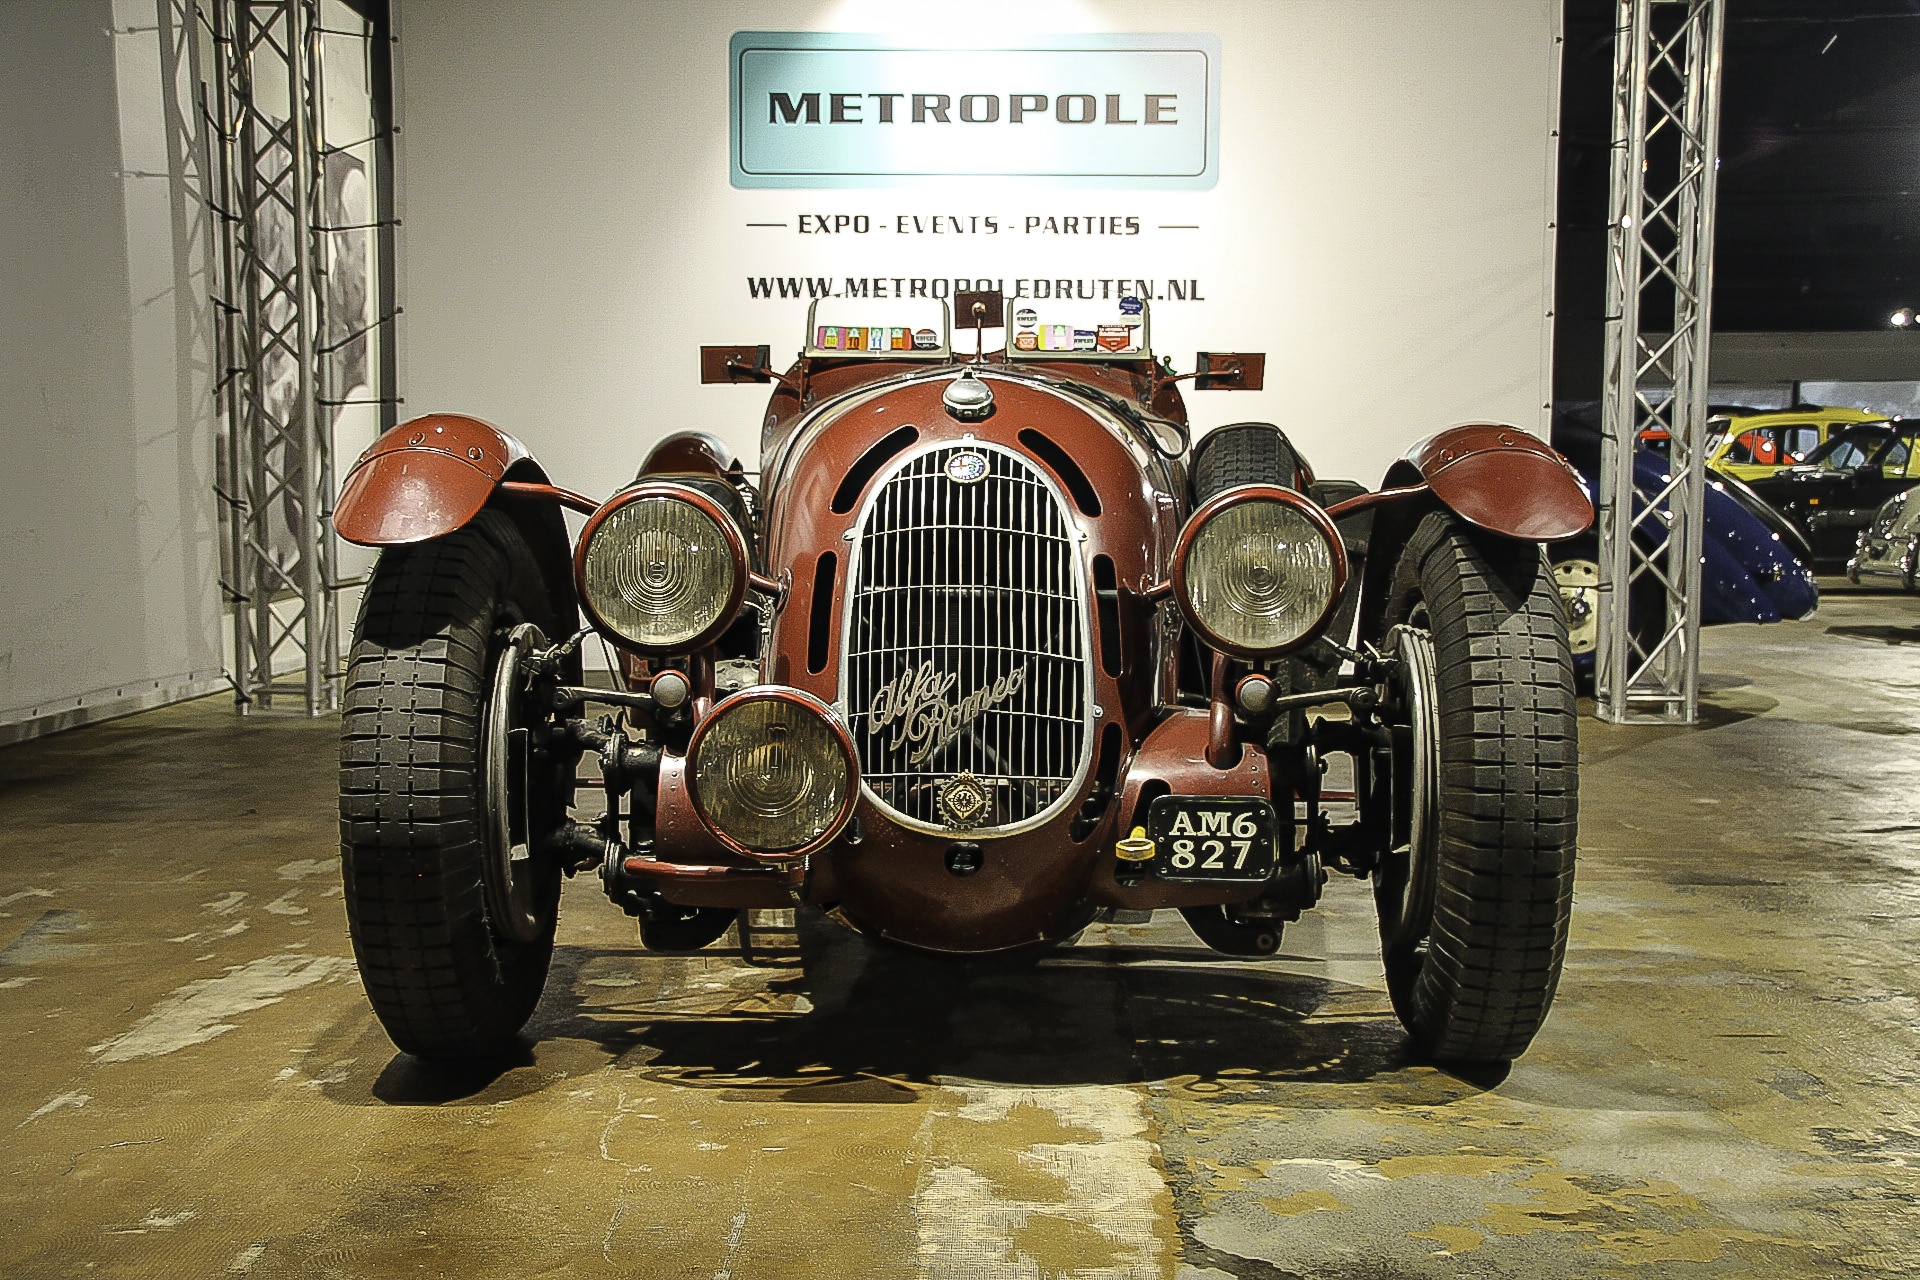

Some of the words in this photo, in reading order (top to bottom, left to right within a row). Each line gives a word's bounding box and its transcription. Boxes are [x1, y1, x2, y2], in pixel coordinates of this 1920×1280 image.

[767, 92, 1178, 125] METROPOLE
[798, 214, 870, 234] EXPO
[896, 215, 998, 234] EVENTS
[1025, 216, 1140, 235] PARTIES
[908, 665, 1026, 764] Romeo
[1168, 811, 1258, 838] AM6
[1171, 839, 1252, 870] 827
